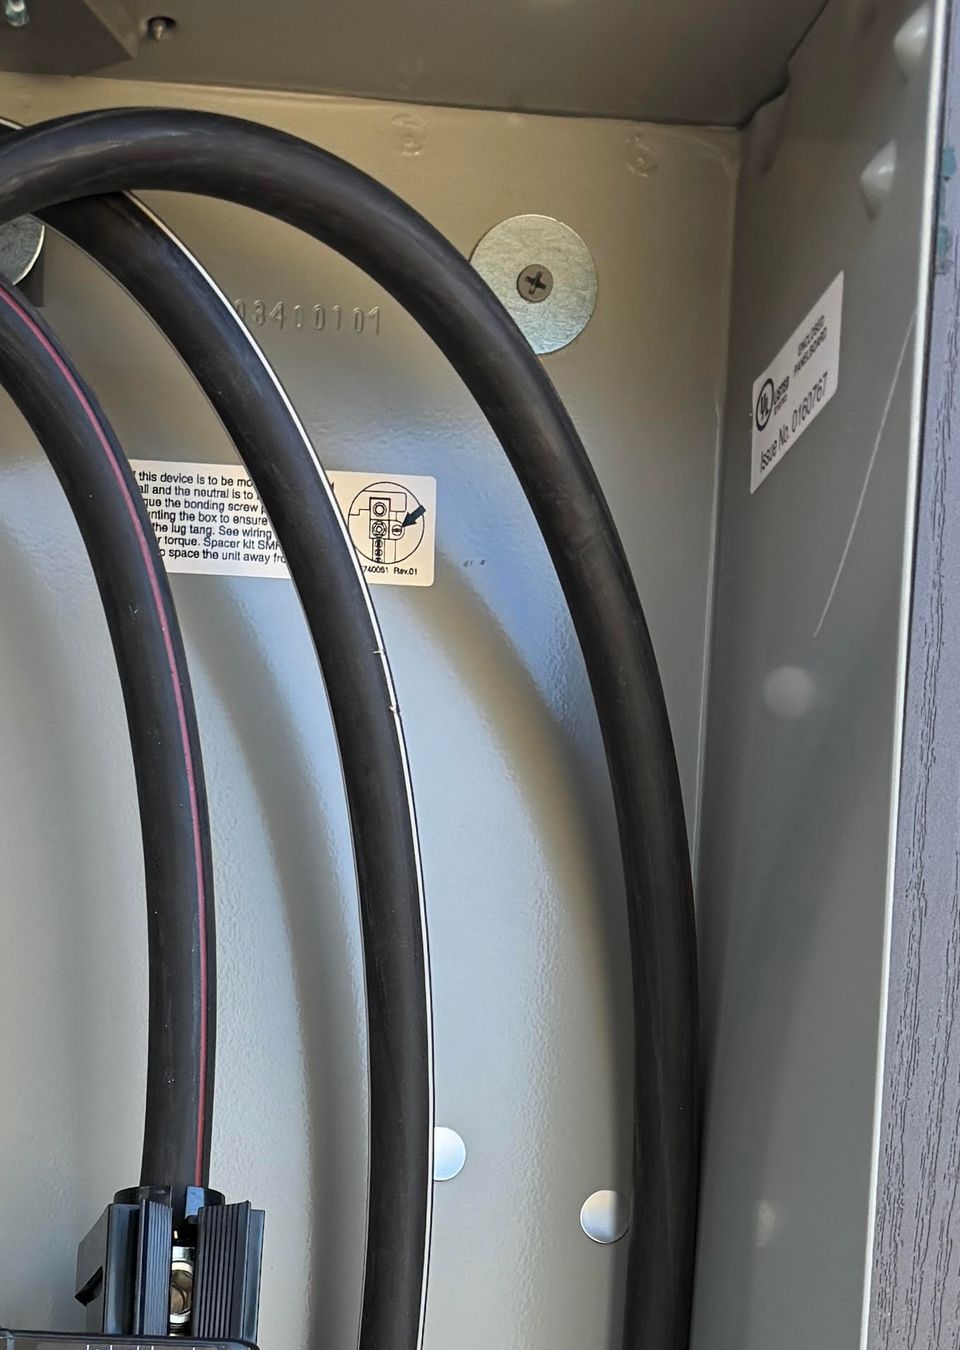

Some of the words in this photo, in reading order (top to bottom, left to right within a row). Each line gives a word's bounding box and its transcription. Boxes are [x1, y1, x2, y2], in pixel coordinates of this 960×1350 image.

[760, 439, 778, 473] Issue
[792, 371, 828, 432] 0160767
[139, 472, 158, 482] this
[160, 473, 194, 484] device
[221, 476, 234, 486] be
[152, 486, 172, 495] and
[175, 486, 191, 496] the
[194, 487, 229, 499] neutral
[165, 498, 181, 508] the
[184, 499, 225, 513] bonding
[228, 502, 259, 513] screw
[179, 511, 196, 521] the
[198, 512, 218, 523] box
[233, 516, 268, 526] ensure
[218, 526, 239, 536] See
[241, 527, 272, 540] wiring
[164, 536, 200, 547] torque.
[203, 538, 241, 550] Spacer
[168, 548, 200, 561] space
[202, 549, 219, 560] the
[221, 550, 241, 561] unit
[243, 552, 270, 565] away
